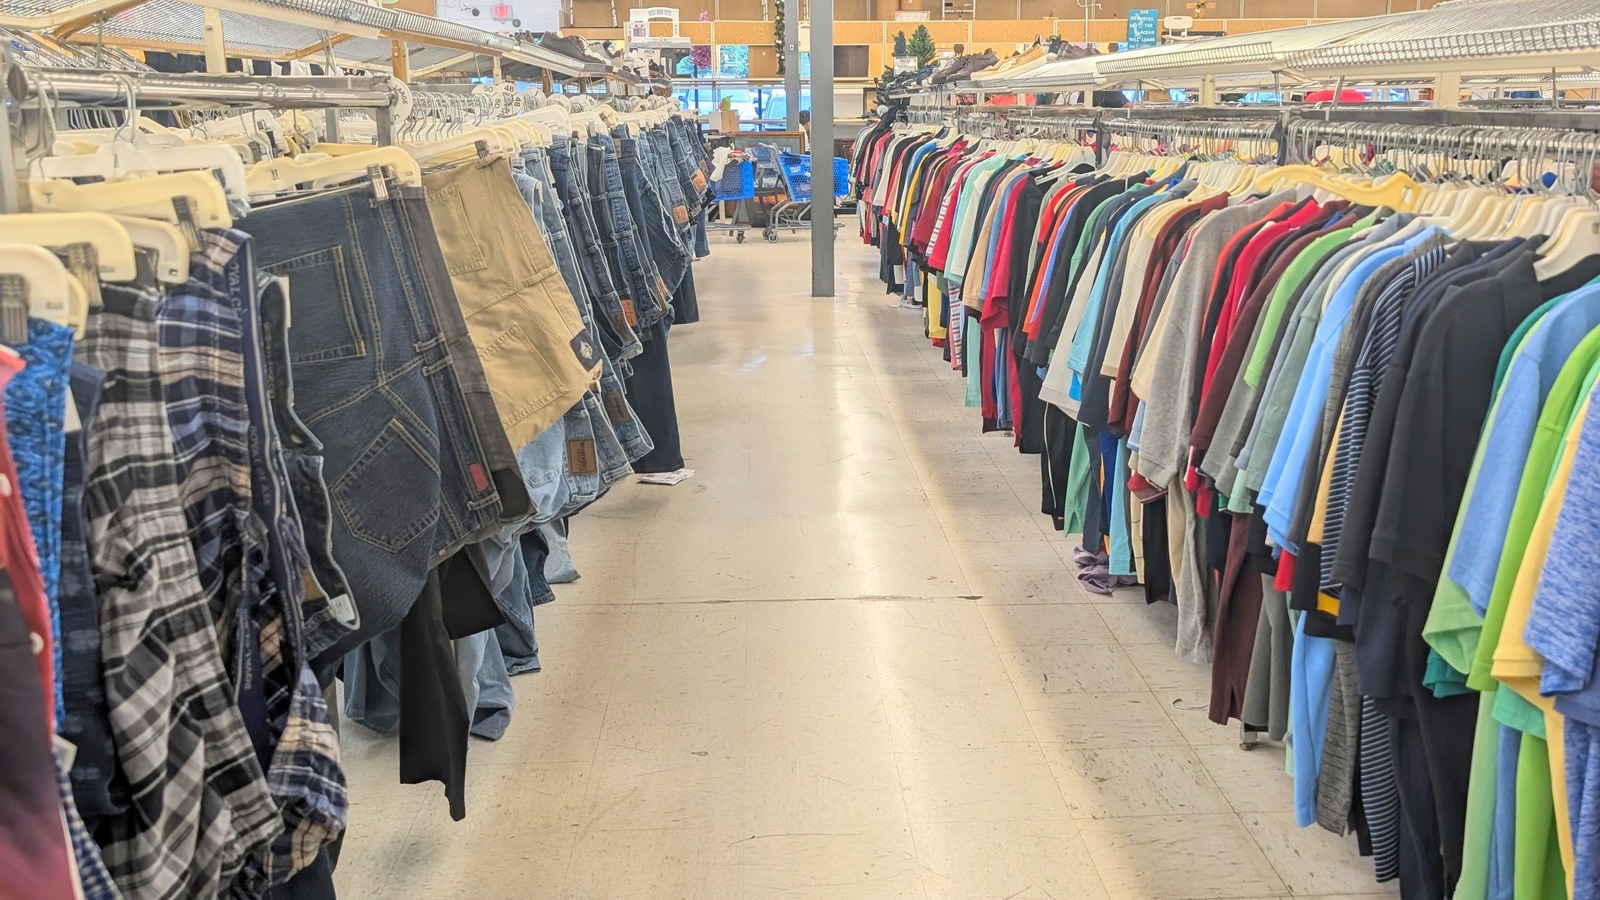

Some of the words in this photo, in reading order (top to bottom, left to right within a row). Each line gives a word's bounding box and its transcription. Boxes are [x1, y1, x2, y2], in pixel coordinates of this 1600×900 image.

[495, 6, 509, 15] EXIT
[392, 85, 408, 105] LARGE
[494, 98, 500, 109] 50
[514, 97, 521, 107] 48
[250, 425, 261, 462] ROYAL
